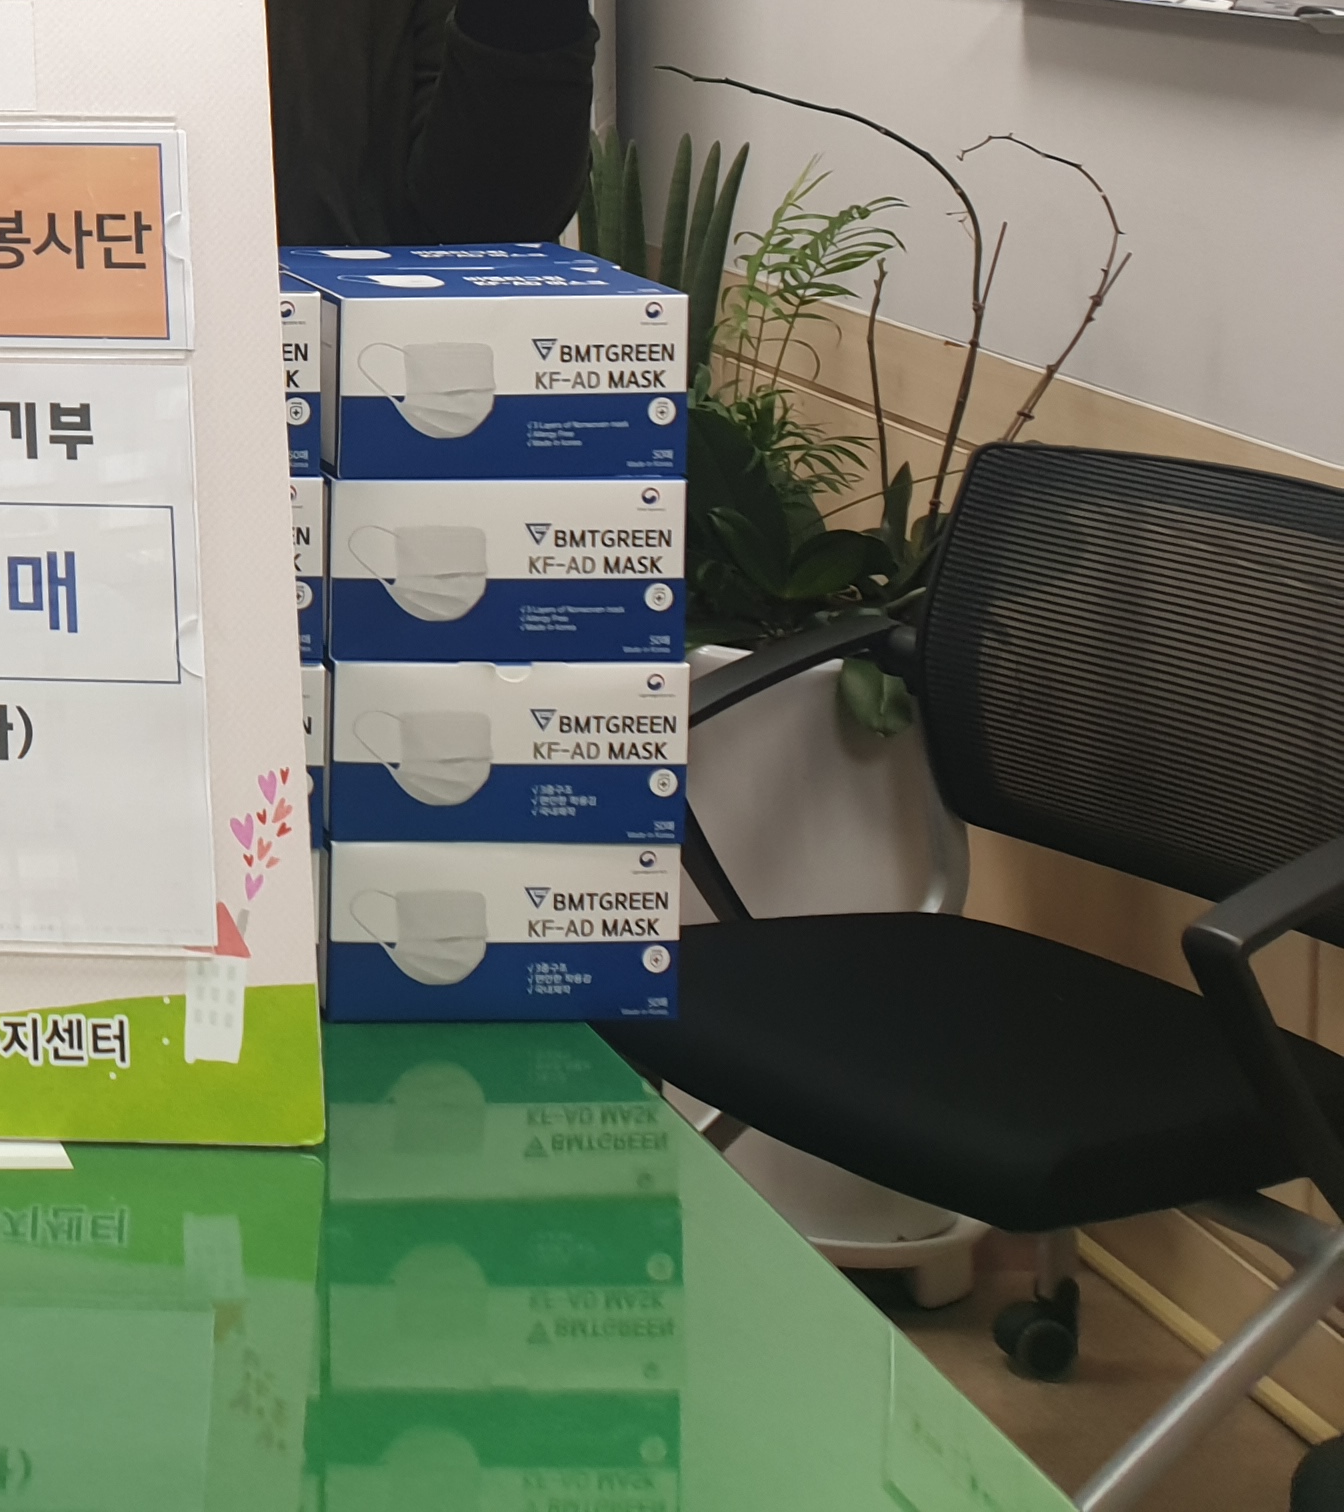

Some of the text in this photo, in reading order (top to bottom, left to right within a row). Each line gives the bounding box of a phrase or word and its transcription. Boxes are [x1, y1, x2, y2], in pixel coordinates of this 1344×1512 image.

[559, 343, 676, 364] BMTGREEN
[535, 369, 667, 390] KF-AD MASK
[553, 529, 673, 549] BMTGREEN
[528, 555, 664, 575] KF-AD MASK
[558, 715, 677, 735] BMTGREEN
[532, 741, 669, 761] KF-AD MASK
[552, 891, 669, 912] BMTGREEN
[527, 918, 661, 938] KF-AD MASK
